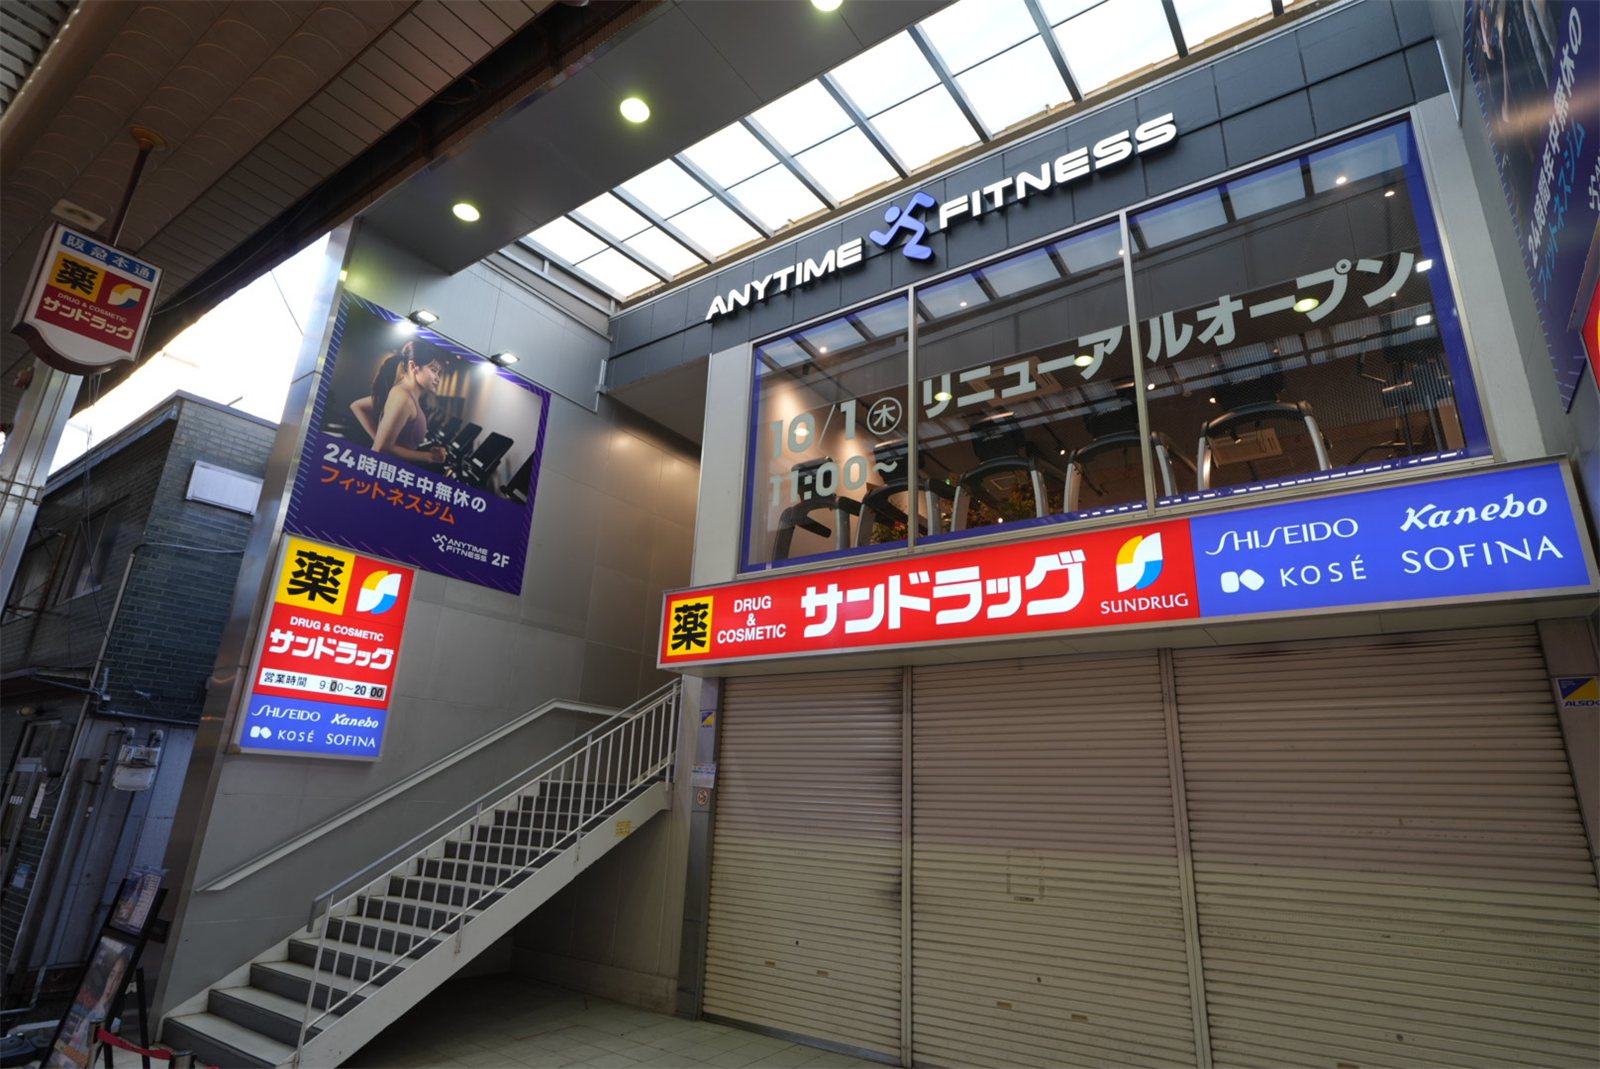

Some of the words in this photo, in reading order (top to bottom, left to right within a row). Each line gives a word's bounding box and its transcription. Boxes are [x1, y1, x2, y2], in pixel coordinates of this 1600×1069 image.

[705, 236, 865, 321] ANYTIME
[938, 112, 1179, 230] FITNESS
[65, 235, 151, 278] 阪急本通
[55, 258, 98, 296] 薬
[43, 296, 135, 340] サンドラッグ
[57, 291, 81, 305] DRUG
[88, 304, 127, 324] COSMETIC
[923, 251, 1415, 419] リニューアルオープン
[320, 464, 455, 525] フィットネスジム
[323, 443, 487, 513] 24時間年中無休の
[1400, 493, 1548, 532] Kanebo
[445, 545, 488, 562] FITNESS
[447, 538, 489, 556] ANYTIME
[1205, 517, 1360, 556] SHISEIDO
[491, 552, 511, 568] 2F
[1280, 554, 1367, 588] KOSÉ
[1400, 535, 1564, 574] SOFINA
[286, 549, 345, 605] 薬
[800, 548, 1087, 639] サンドラッグ
[733, 595, 773, 612] DRUG
[746, 613, 757, 627] &
[1100, 592, 1189, 615] SUNDRUG
[289, 616, 321, 631] DRUG
[322, 623, 331, 632] &
[333, 624, 385, 642] COSMETIC
[670, 603, 709, 652] 薬
[716, 623, 787, 645] COSMETIC
[268, 628, 395, 671] サンドラッグ
[263, 671, 308, 688] 営業時間
[251, 704, 321, 722] SHISEIDO
[330, 713, 380, 729] Kanebo
[277, 729, 315, 743] KOSÉ
[325, 733, 377, 748] SOFINA
